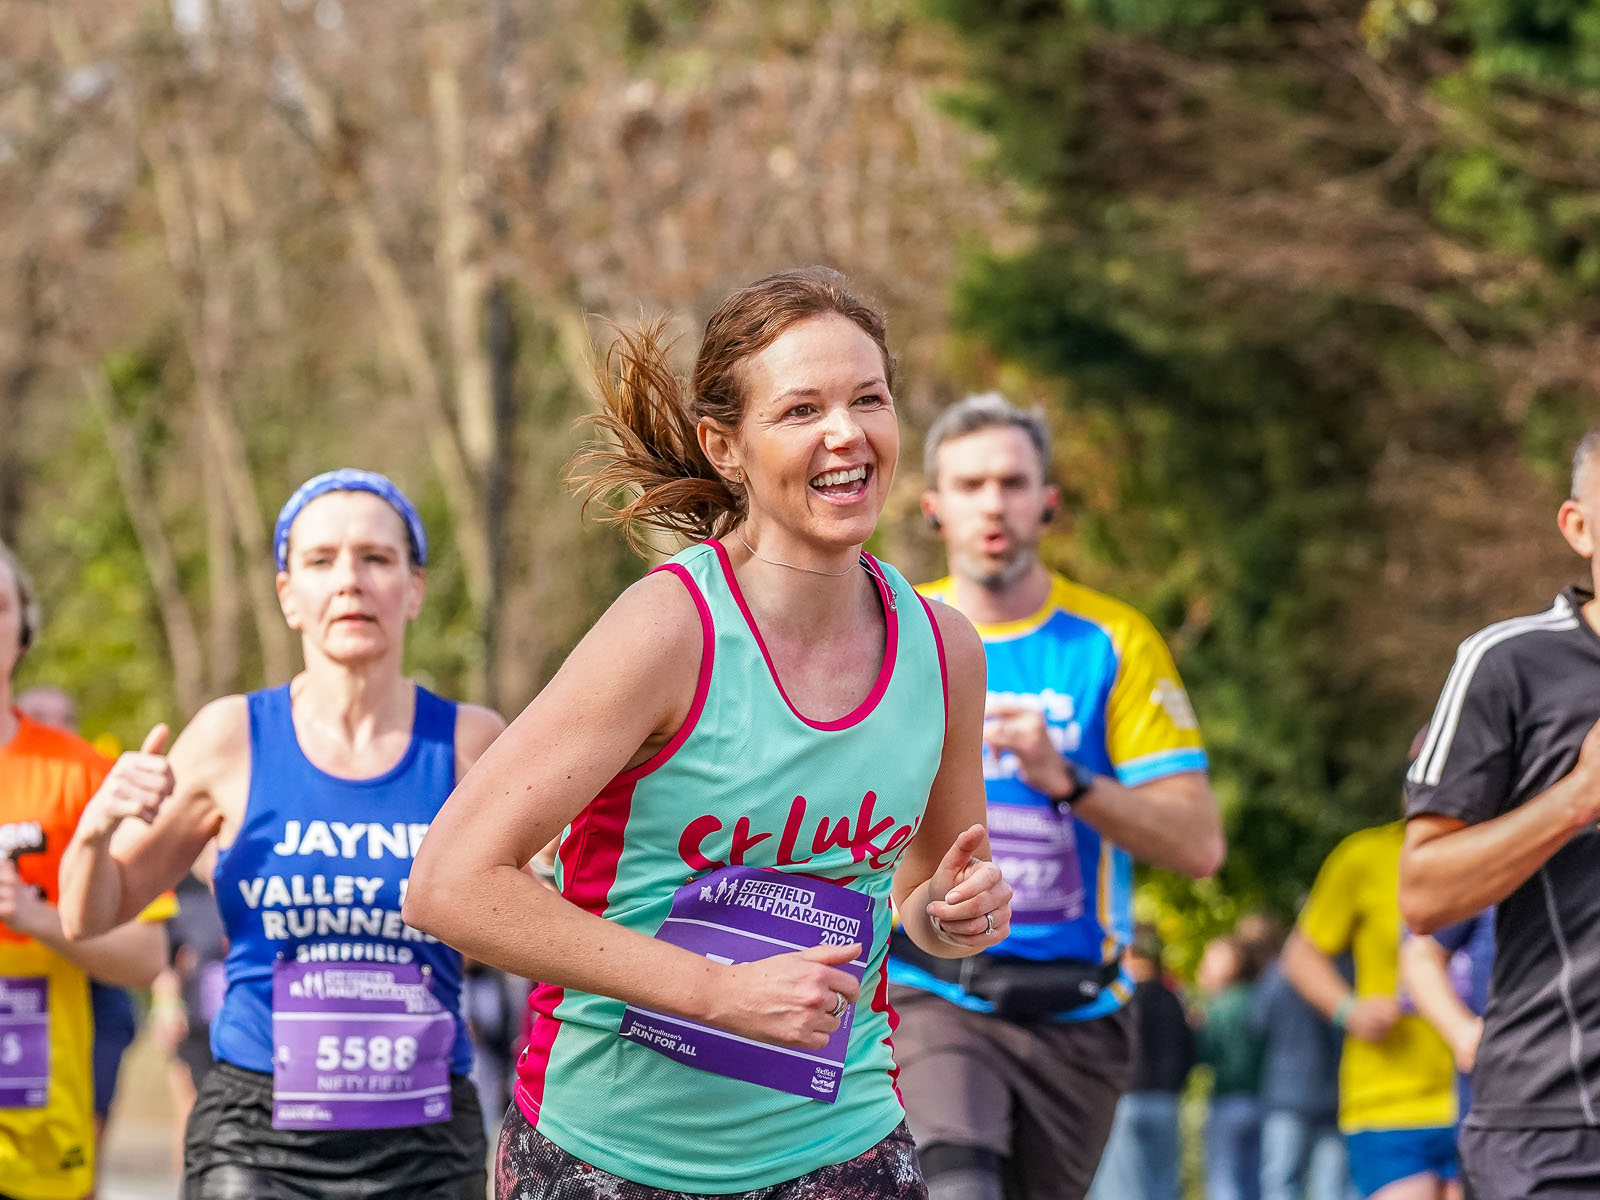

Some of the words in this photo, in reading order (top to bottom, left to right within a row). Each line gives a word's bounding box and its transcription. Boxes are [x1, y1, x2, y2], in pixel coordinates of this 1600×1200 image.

[238, 874, 385, 909] VALLEY
[741, 881, 812, 905] SHEFFIELD
[261, 907, 441, 944] RUNNE
[734, 893, 774, 912] HALF
[774, 901, 858, 935] MARATHON
[296, 942, 414, 964] SHEFFIELD
[315, 1035, 418, 1071] 5588
[630, 1025, 653, 1042] RUN
[654, 1035, 676, 1050] FOR
[677, 1043, 697, 1057] ALL
